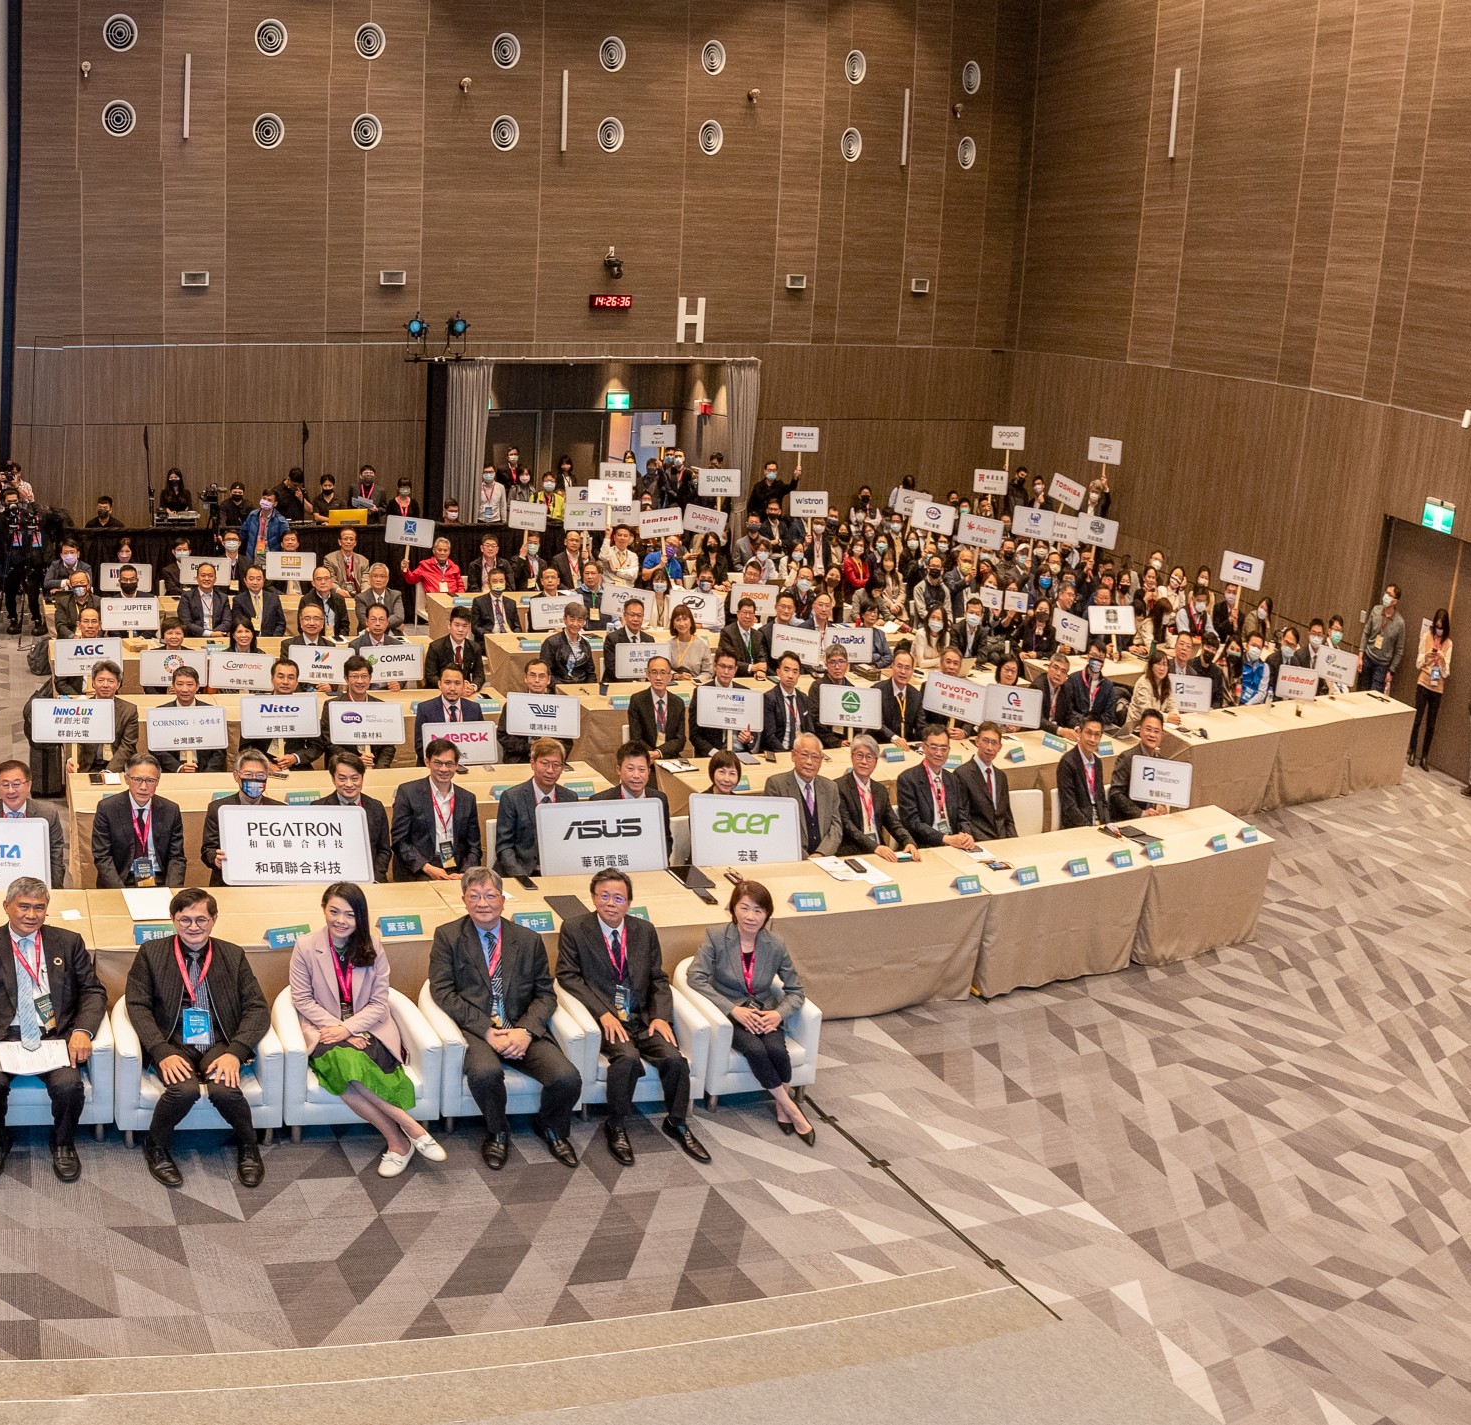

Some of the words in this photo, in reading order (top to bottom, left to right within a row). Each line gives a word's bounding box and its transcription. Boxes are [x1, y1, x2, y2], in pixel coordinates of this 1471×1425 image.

[595, 296, 631, 306] 14:26:36
[676, 297, 706, 343] H
[706, 475, 732, 483] SUNON
[1055, 479, 1081, 498] TOSHIBA
[795, 497, 823, 505] wistron
[642, 514, 678, 524] LemTech
[691, 511, 720, 525] DARFON
[282, 557, 300, 565] SMP
[740, 591, 770, 600] PHISON
[832, 634, 866, 645] DynaPack
[74, 644, 104, 657] AGC
[379, 653, 416, 664] COMPAL
[226, 659, 263, 671] Coretronic
[380, 670, 404, 678] 仁寶電腦
[229, 677, 255, 686] 中強光電
[1280, 674, 1316, 687] winbond
[259, 703, 300, 713] Nitto
[543, 705, 558, 714] USI
[54, 717, 90, 725] 群創光電
[152, 718, 189, 727] CORNING
[57, 729, 90, 738] 群創光電
[266, 724, 296, 733] 台灣日東
[353, 731, 382, 739] 明基材料
[173, 736, 203, 745] 台灣康寧
[712, 811, 780, 835] acer
[247, 822, 342, 837] PEGATRON
[563, 817, 642, 841] ASUS
[249, 839, 344, 849] 和碩聯合科技
[738, 849, 759, 862] 宏碁
[581, 854, 630, 869] 華碩電腦
[255, 861, 342, 875] 和碩聯合科技
